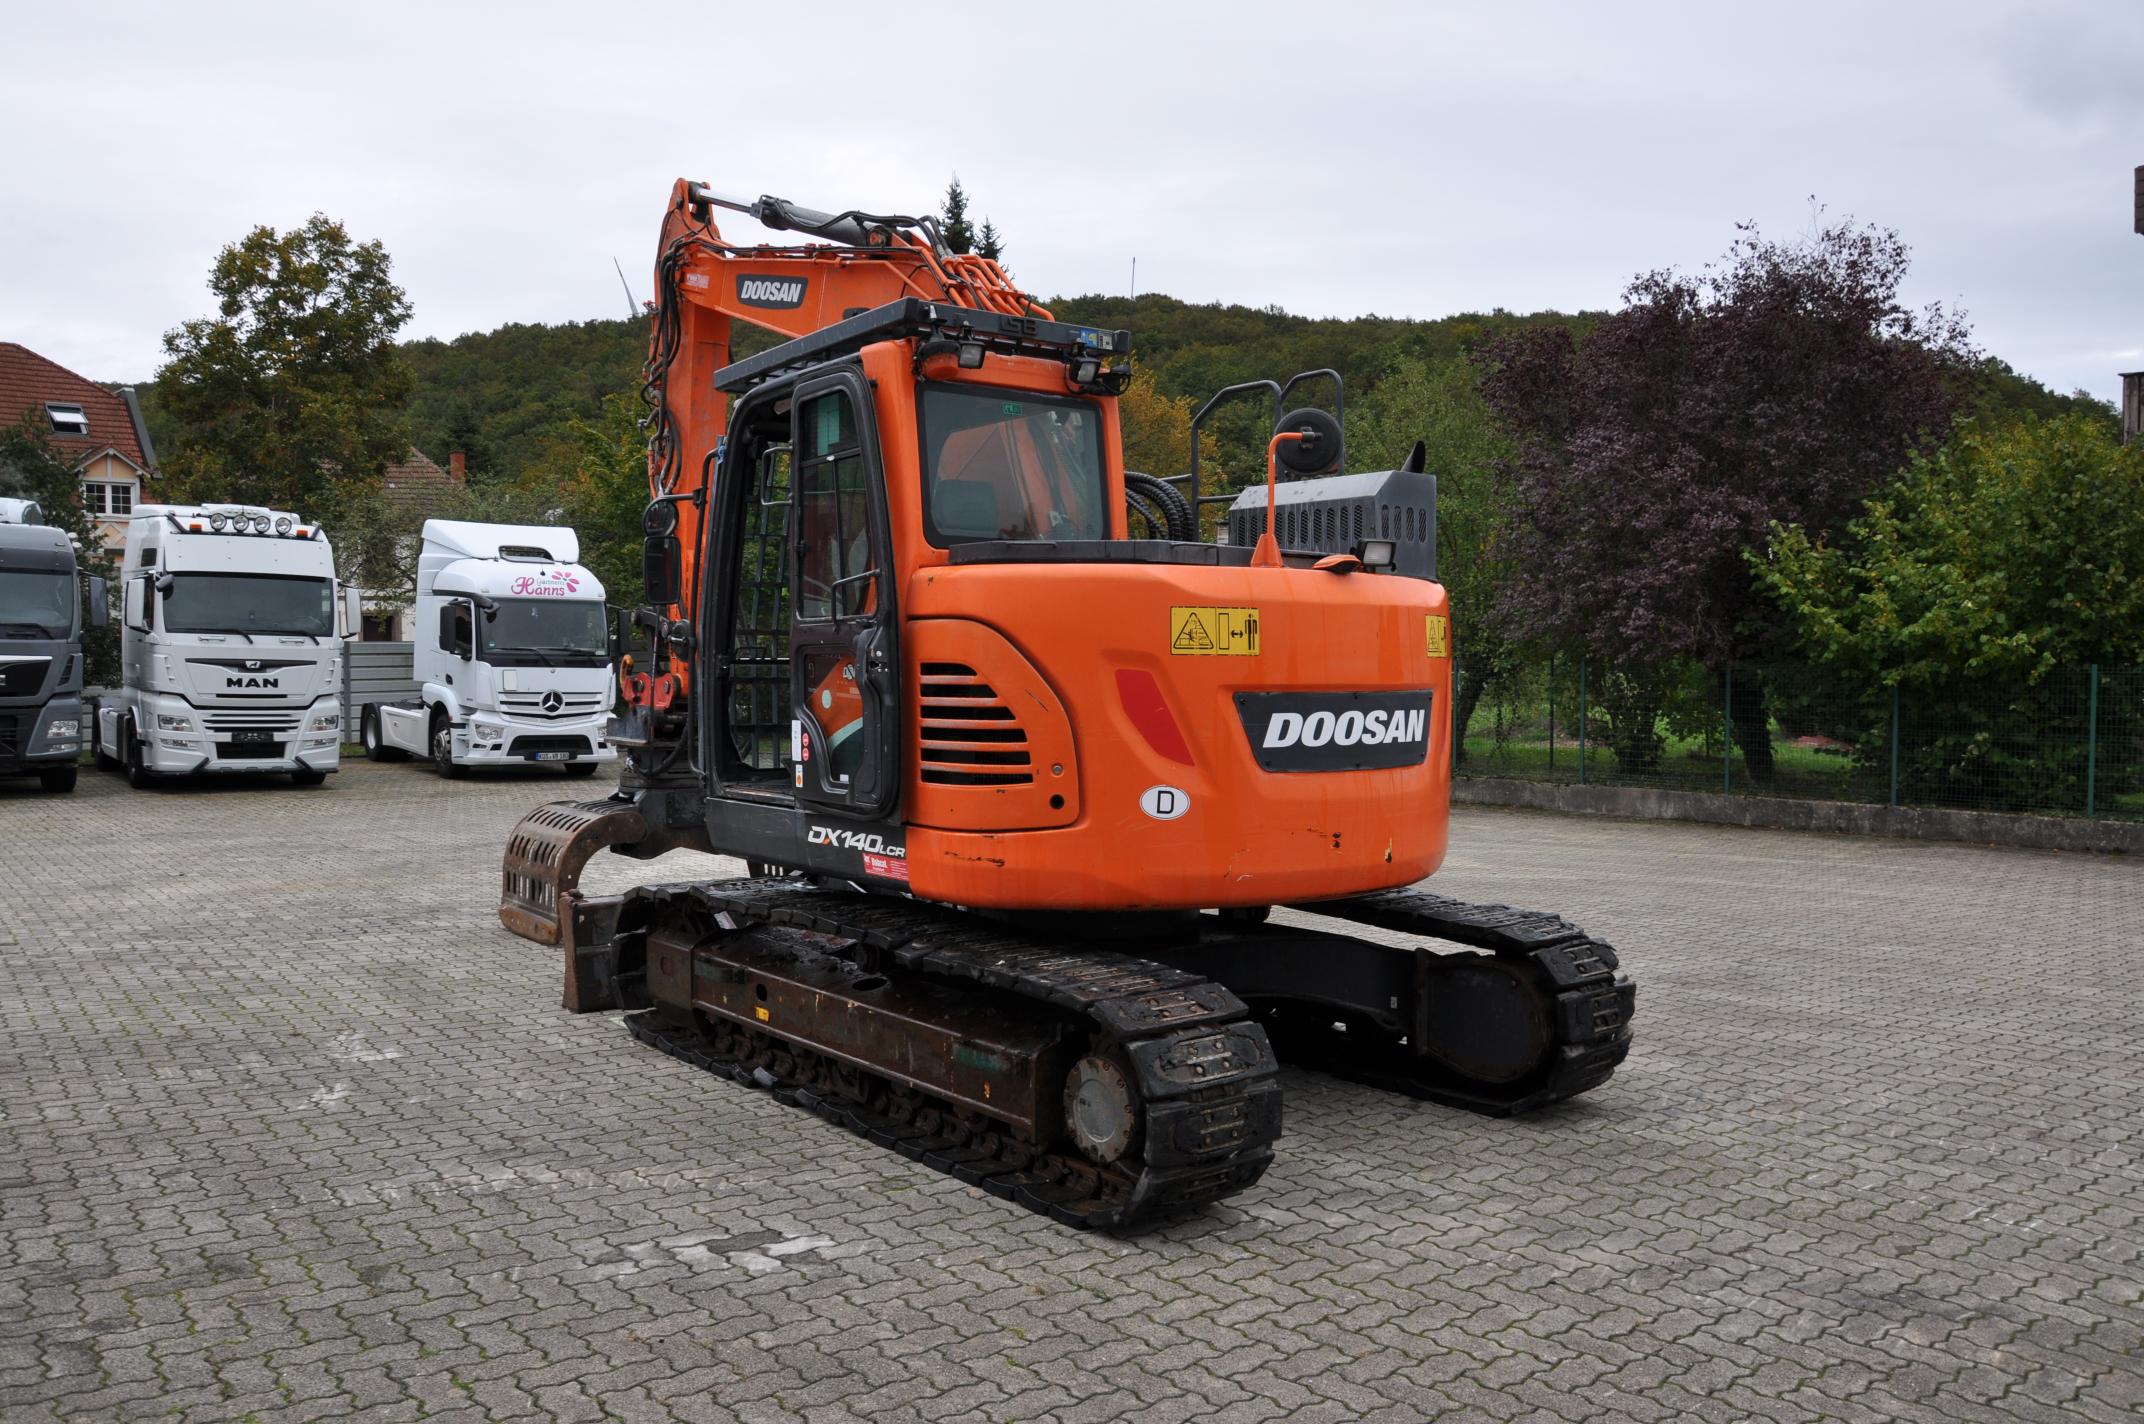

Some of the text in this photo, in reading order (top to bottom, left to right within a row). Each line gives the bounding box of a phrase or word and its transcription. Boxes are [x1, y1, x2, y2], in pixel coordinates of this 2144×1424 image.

[741, 280, 802, 303] DOOSAN
[511, 577, 565, 597] Hanns
[226, 677, 279, 688] MAN
[1263, 709, 1425, 748] DOOSAN
[1157, 790, 1175, 814] D
